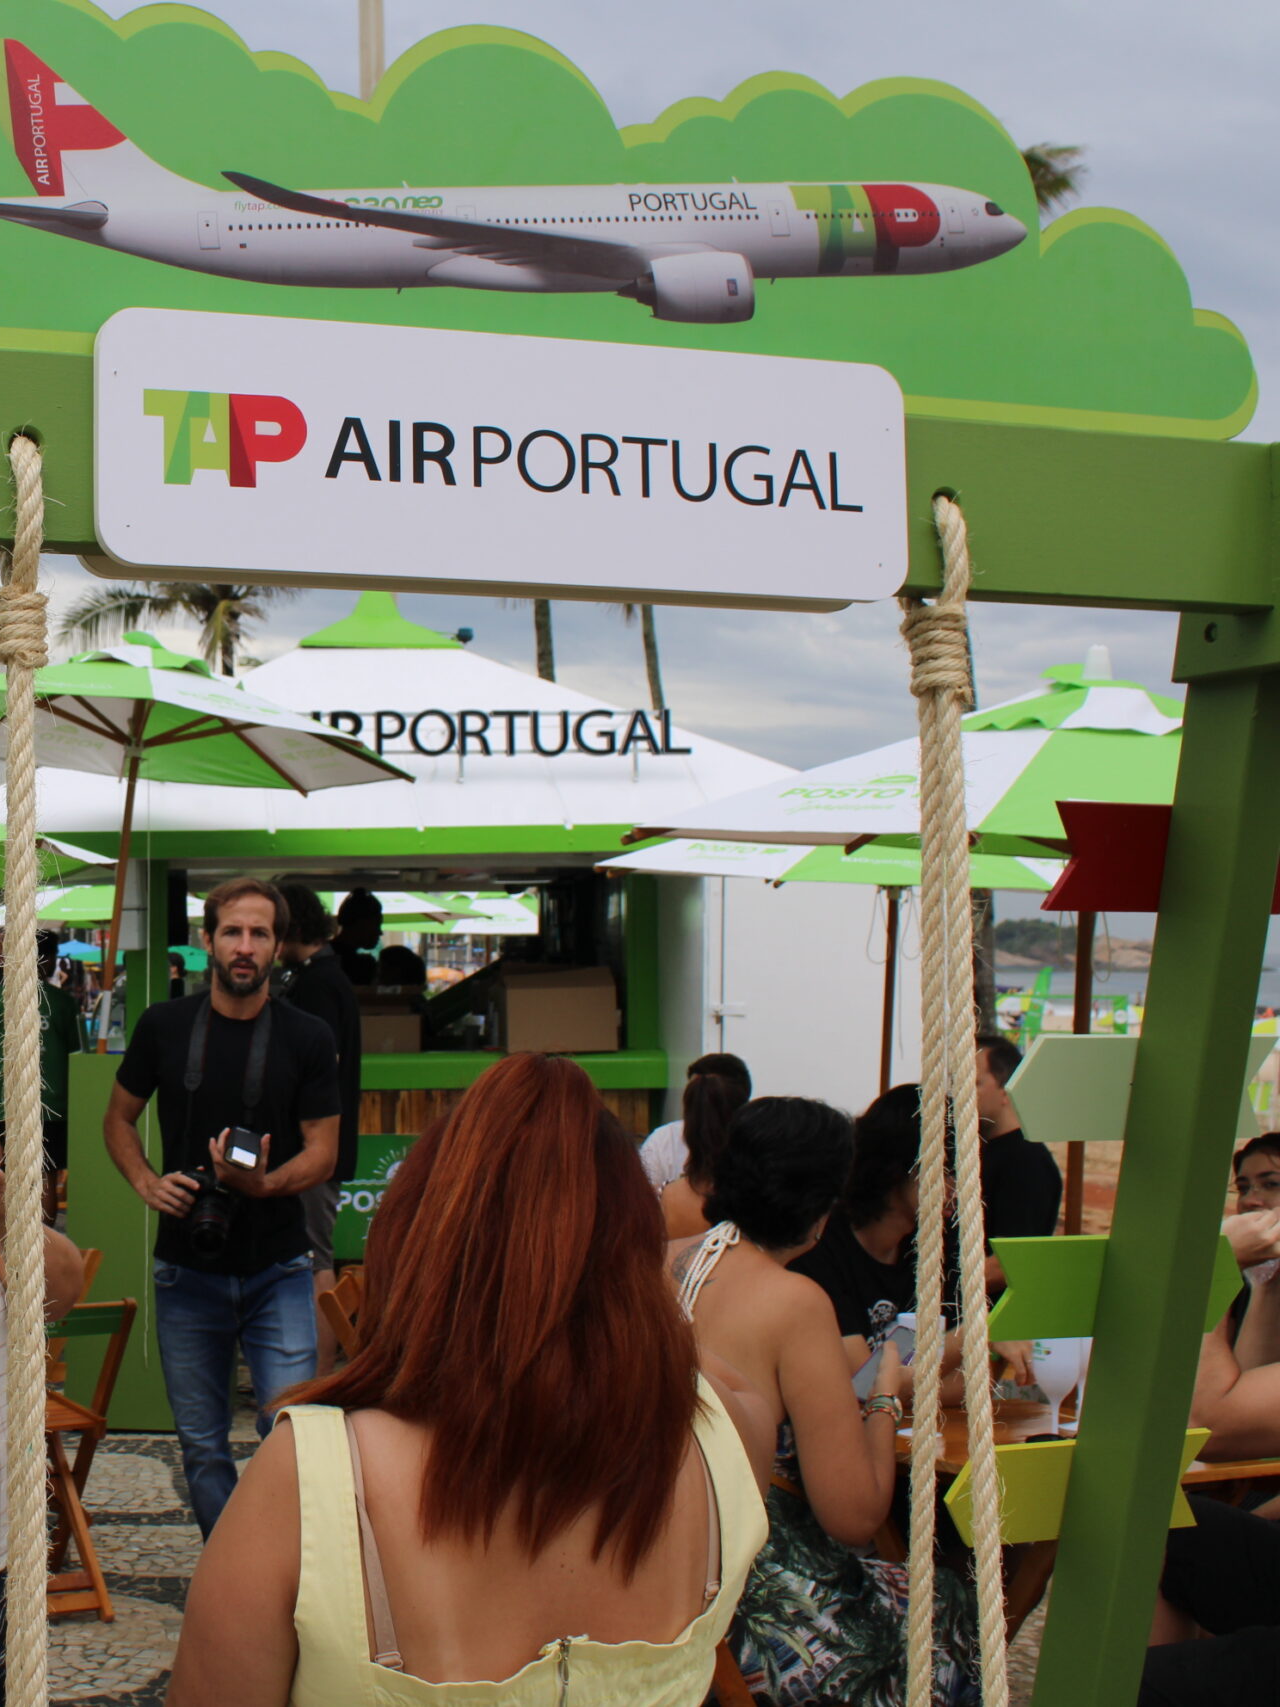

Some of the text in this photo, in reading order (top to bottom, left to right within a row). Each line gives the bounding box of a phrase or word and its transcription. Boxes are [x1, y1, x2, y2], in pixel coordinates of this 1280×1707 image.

[628, 192, 758, 212] PORTUGAL
[143, 388, 308, 488] TAP
[374, 708, 692, 757] PORTUGAL
[778, 787, 906, 799] POSTO
